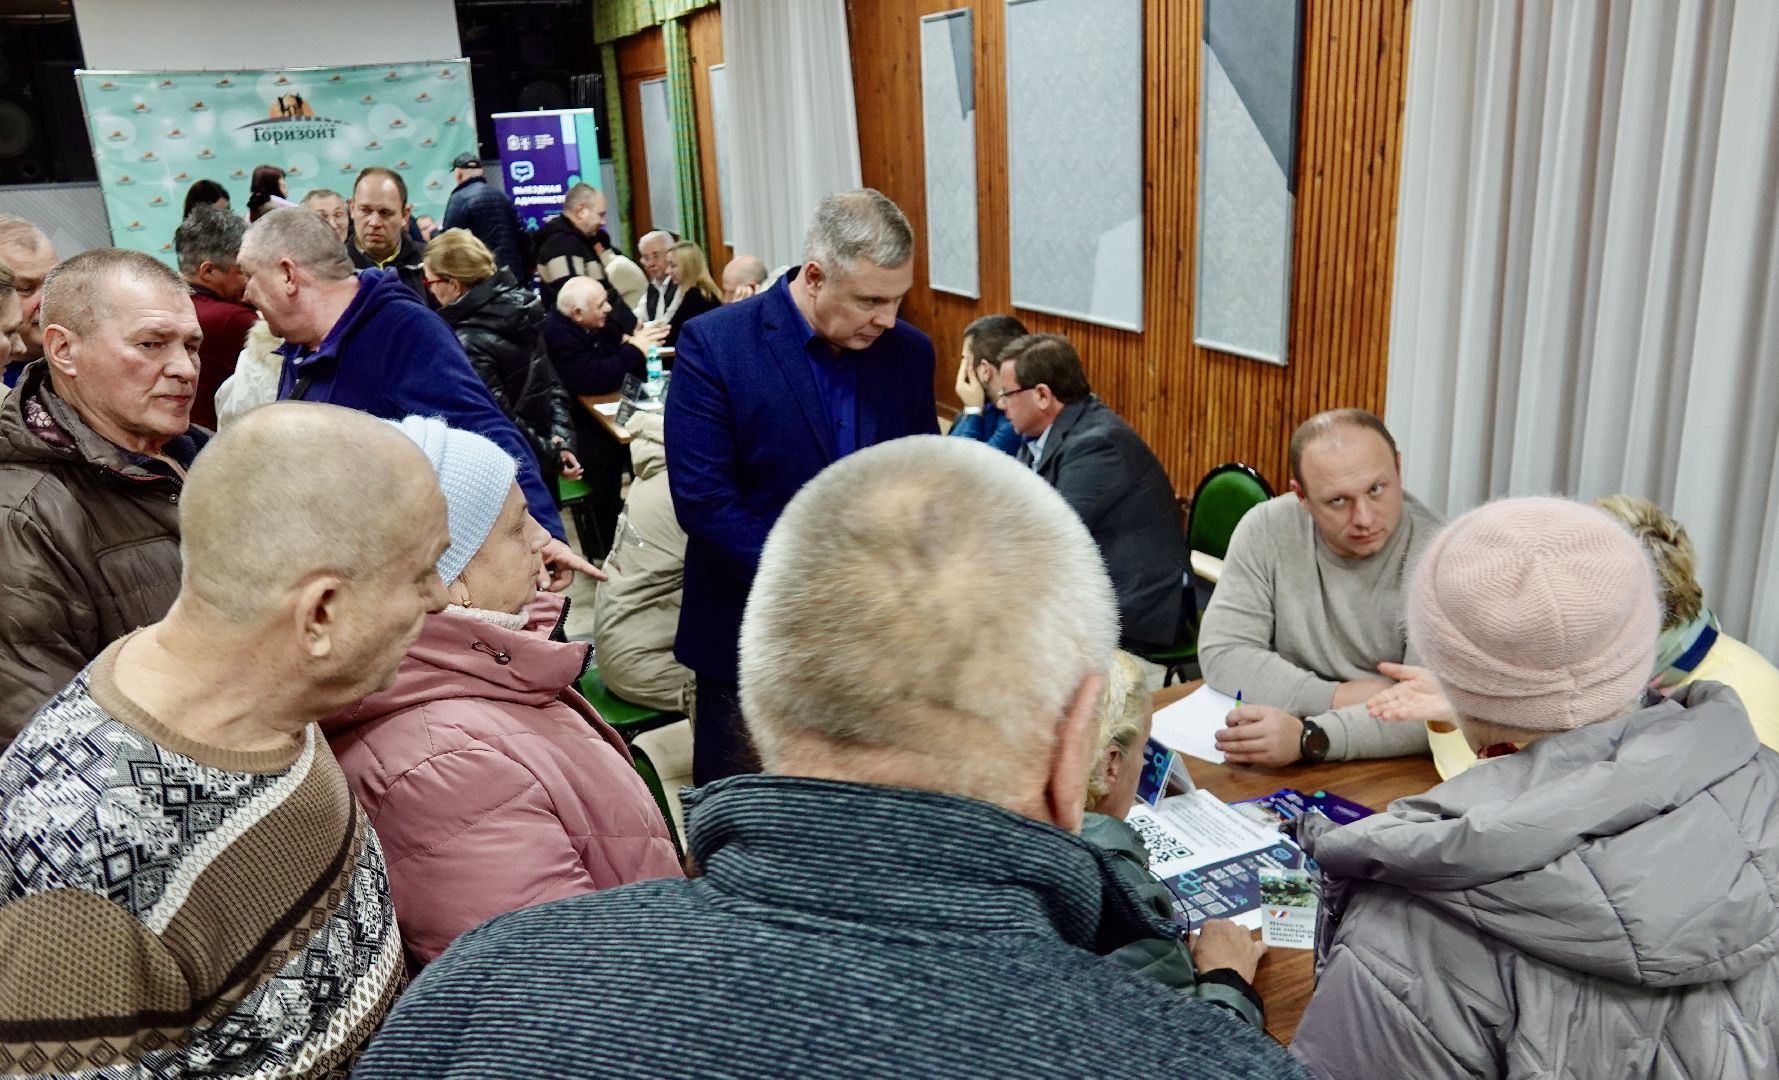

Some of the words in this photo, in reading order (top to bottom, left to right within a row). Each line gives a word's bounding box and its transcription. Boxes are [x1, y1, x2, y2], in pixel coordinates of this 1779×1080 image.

[253, 127, 337, 145] Горизонт
[512, 184, 562, 195] ВЫЕЗДНАЯ
[514, 194, 567, 206] АДМИНИСТ
